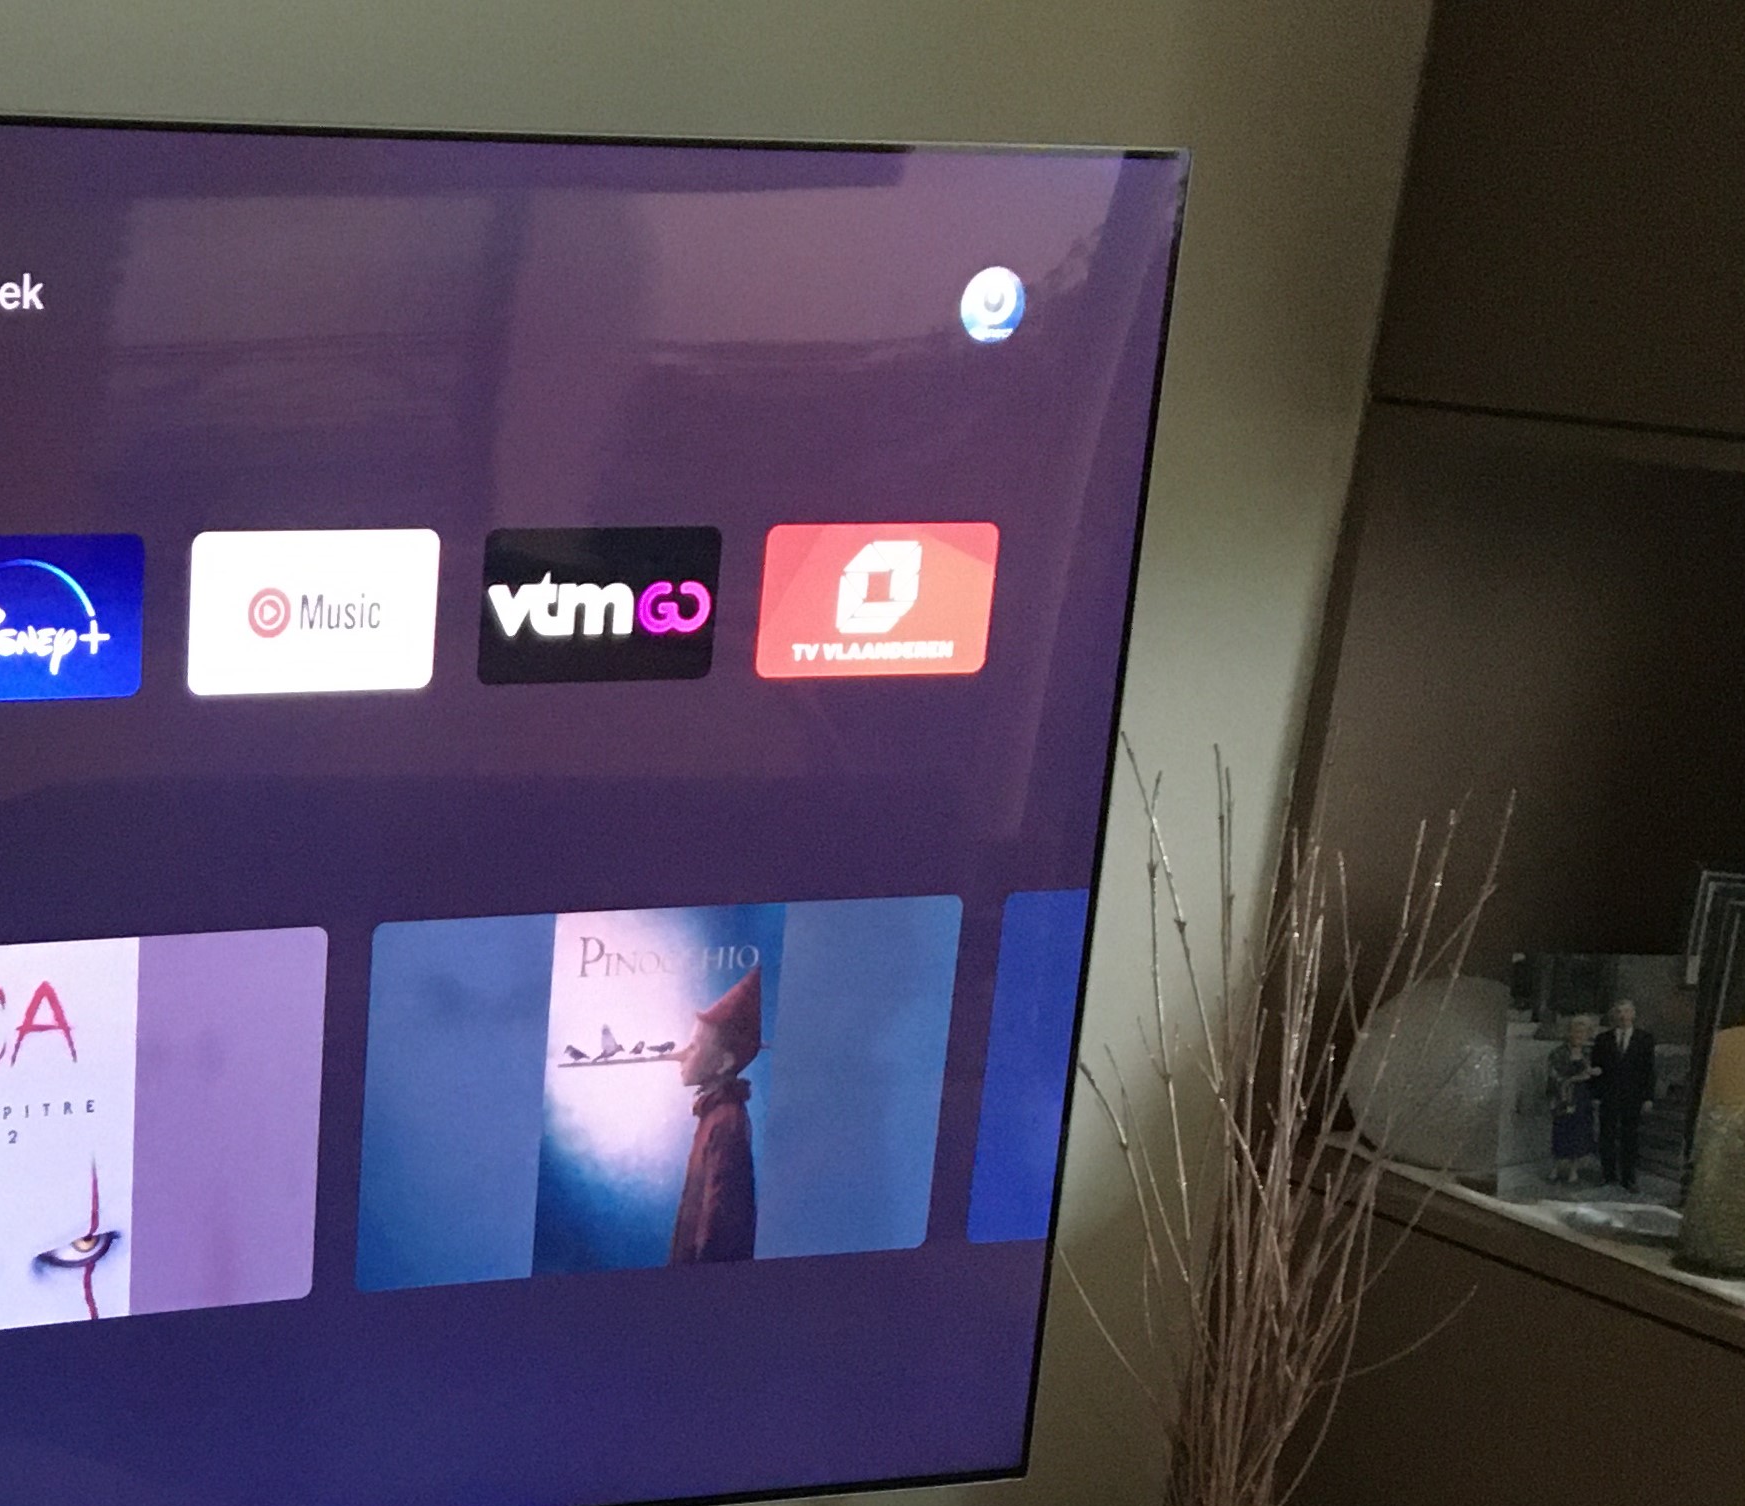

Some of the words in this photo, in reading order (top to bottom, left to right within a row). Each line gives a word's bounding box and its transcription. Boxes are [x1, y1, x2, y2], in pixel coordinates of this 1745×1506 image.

[299, 592, 381, 630] Music
[791, 642, 819, 662] TV
[823, 640, 954, 661] VLAANDEREN
[579, 935, 760, 978] PINOCHIO
[7, 1130, 18, 1145] 2
